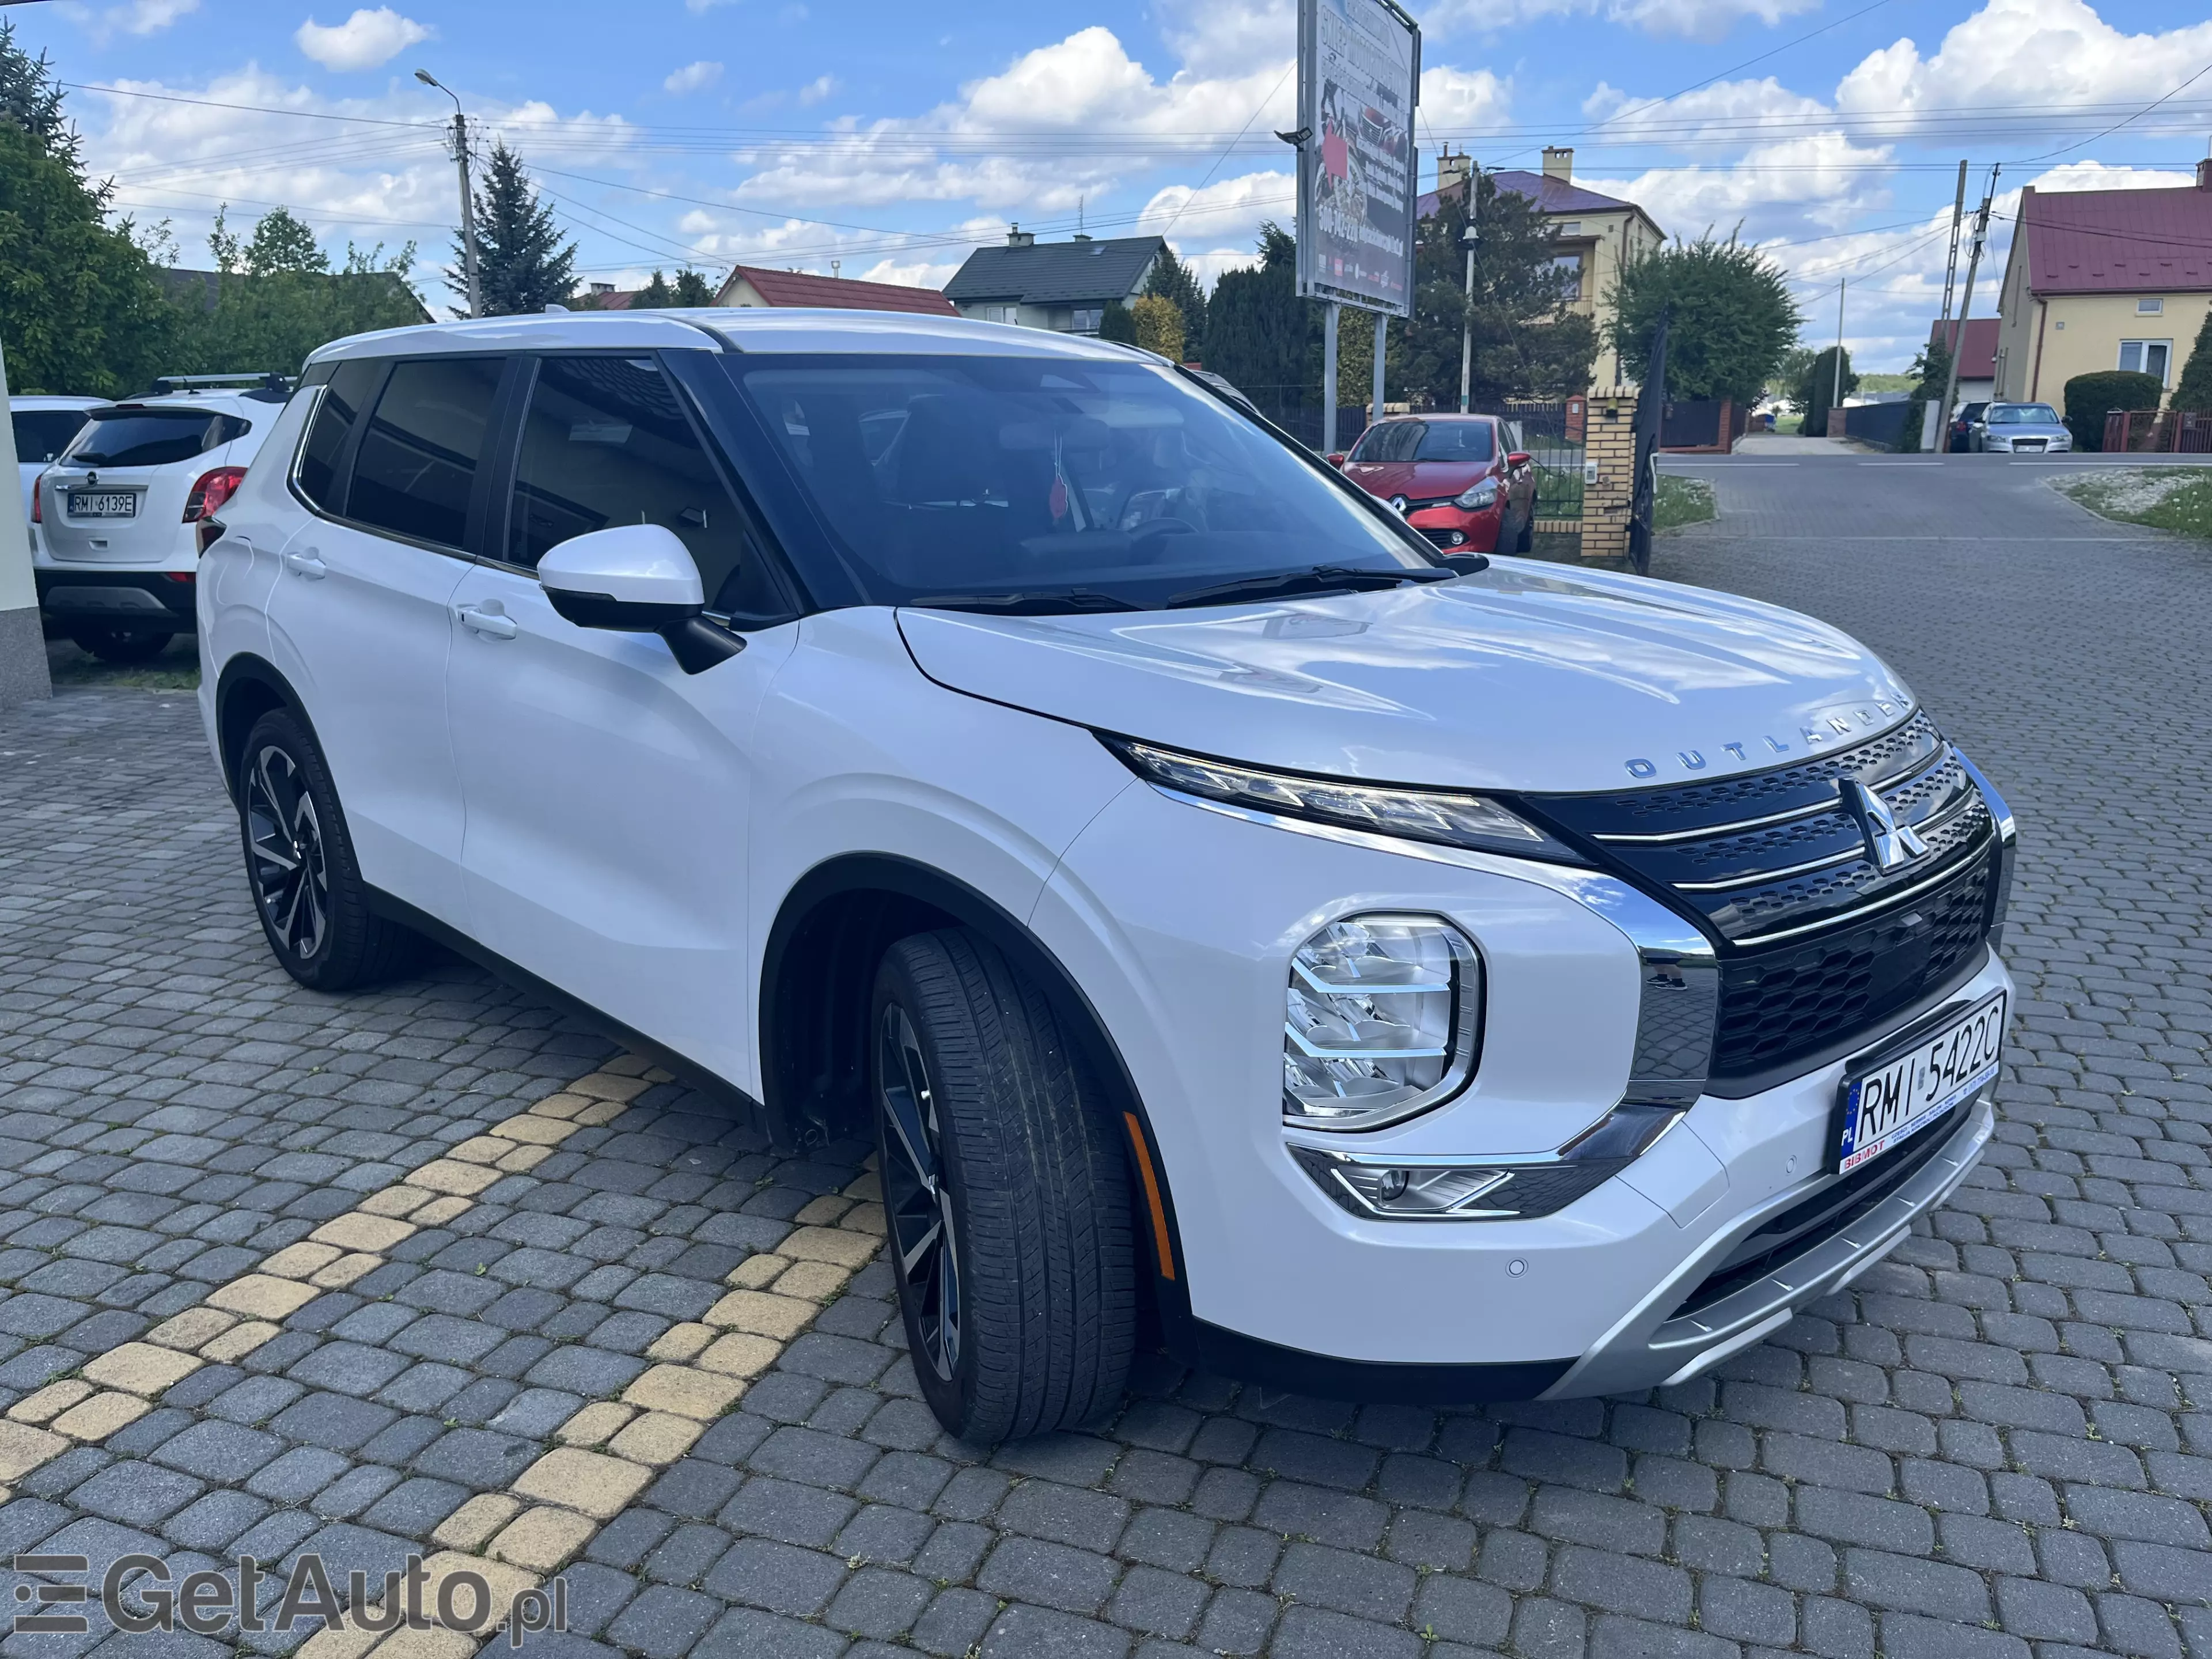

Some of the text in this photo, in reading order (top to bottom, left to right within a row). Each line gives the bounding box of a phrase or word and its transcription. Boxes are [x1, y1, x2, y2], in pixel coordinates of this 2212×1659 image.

[1321, 5, 1347, 58] SKLEP
[74, 496, 93, 512] RMI
[98, 496, 132, 512] 6139E
[1624, 688, 1911, 778] OUTLANDER
[1858, 1006, 1998, 1143] RMI 5422C
[1841, 1128, 1854, 1146] PL
[1844, 1140, 1885, 1169] BIBMOT
